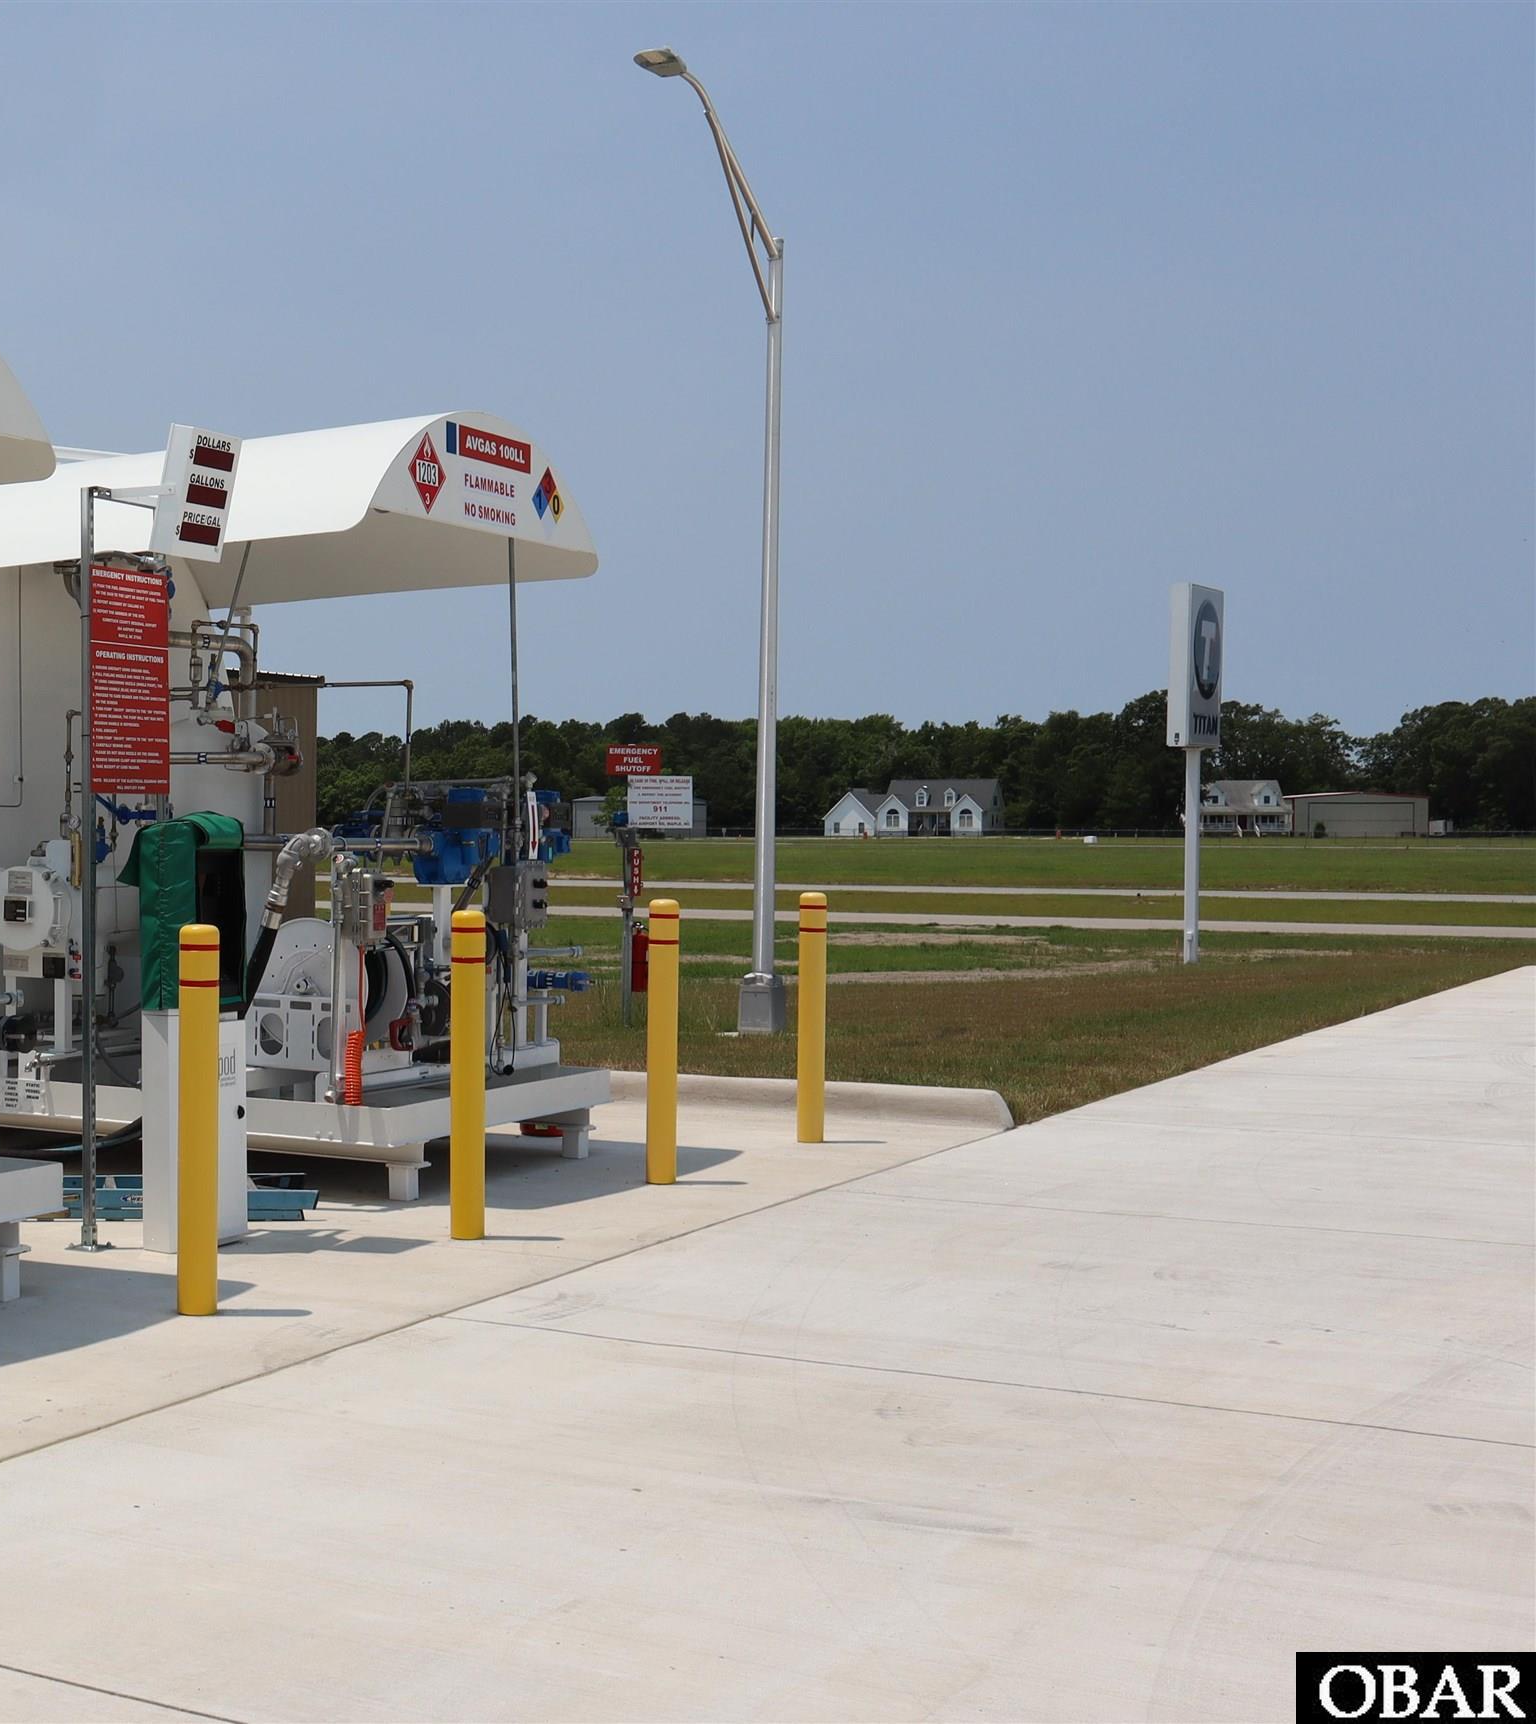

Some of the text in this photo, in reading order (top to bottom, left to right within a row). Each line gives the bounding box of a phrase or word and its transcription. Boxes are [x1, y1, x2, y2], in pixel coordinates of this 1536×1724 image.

[196, 435, 231, 451] DOLLARS
[465, 434, 526, 464] AVGAS 100LL
[190, 473, 225, 489] GALLONS
[417, 461, 437, 485] 1203
[464, 473, 515, 498] FLAMMABLE
[425, 493, 430, 505] 3
[552, 495, 560, 515] 0
[464, 502, 516, 526] NO SMOKING
[92, 568, 163, 586] EMERGENCY INSTRUCTIONS
[95, 650, 164, 664] OPERATING INSTRUCTIONS
[1193, 713, 1217, 736] TITAN
[609, 747, 658, 755] EMERGENCY
